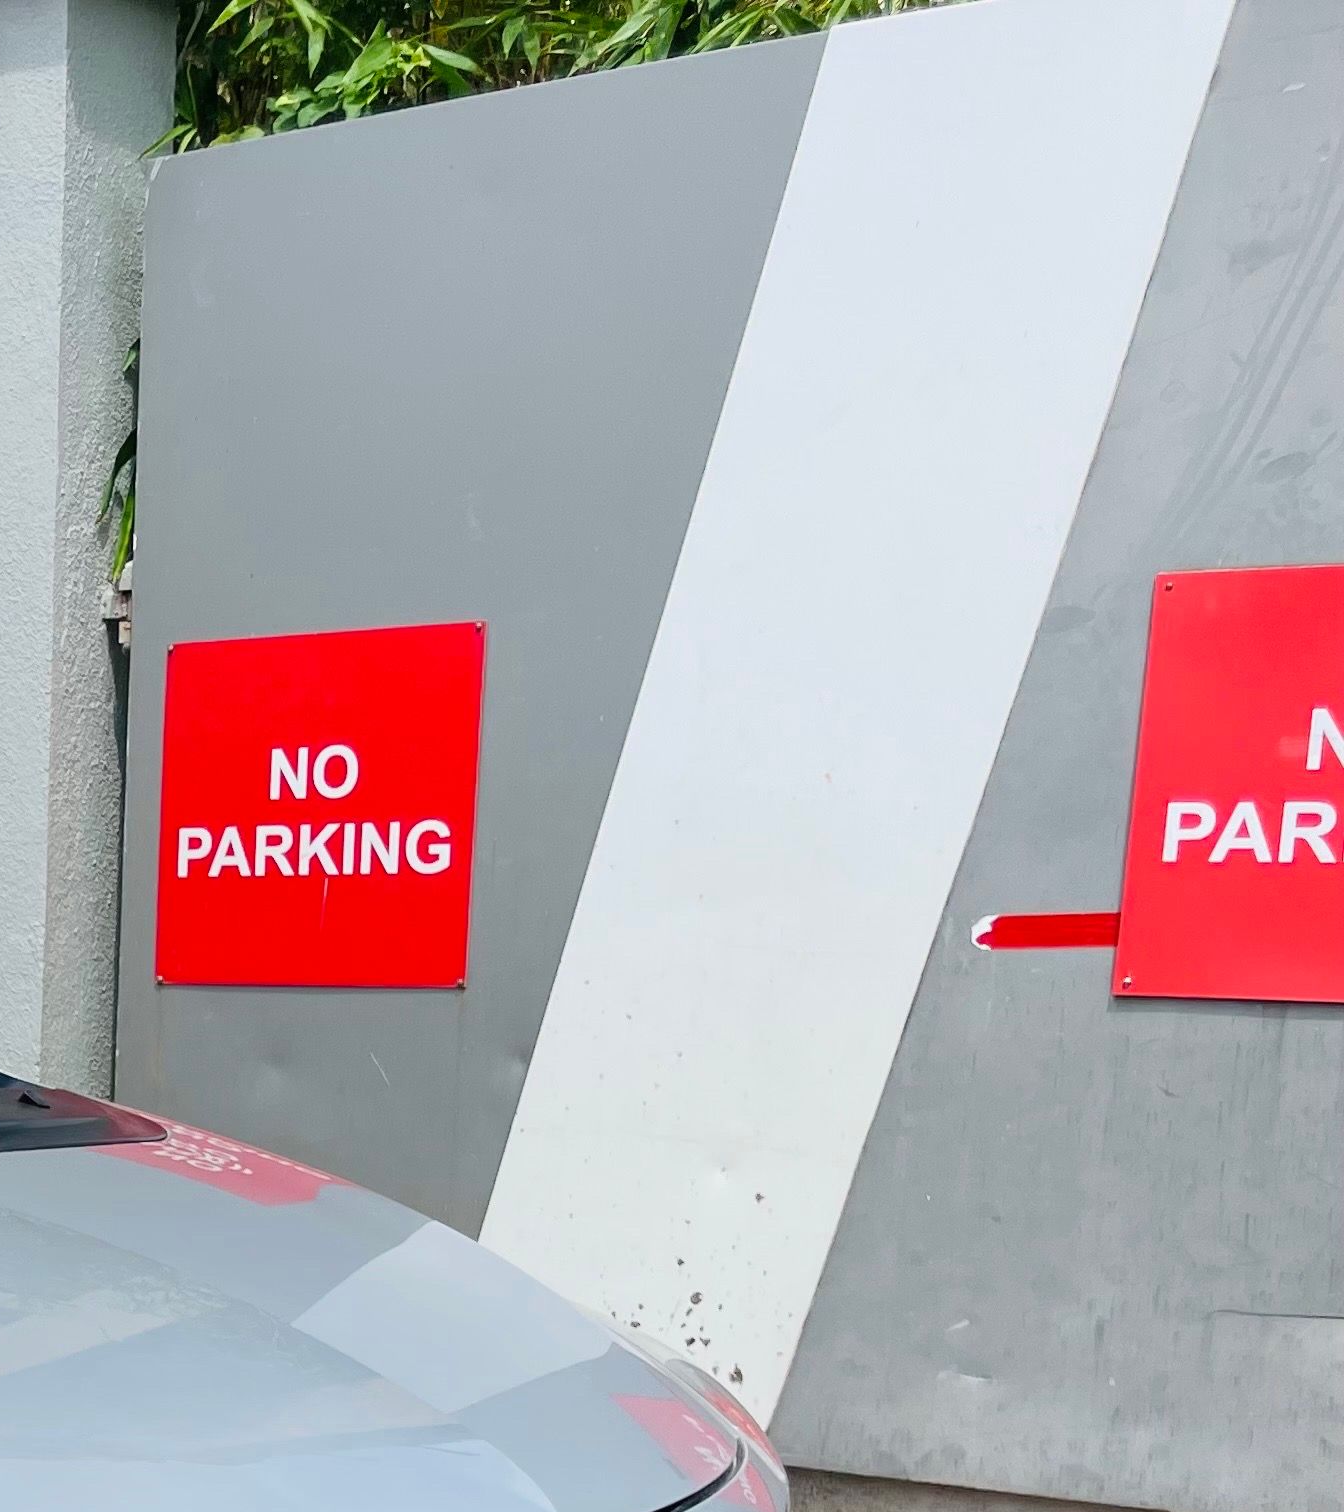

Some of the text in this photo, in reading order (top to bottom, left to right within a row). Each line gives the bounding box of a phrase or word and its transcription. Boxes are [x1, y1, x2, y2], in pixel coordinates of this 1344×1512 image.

[269, 744, 359, 800] NO
[177, 819, 452, 878] PARKING
[1161, 801, 1344, 863] PAR
